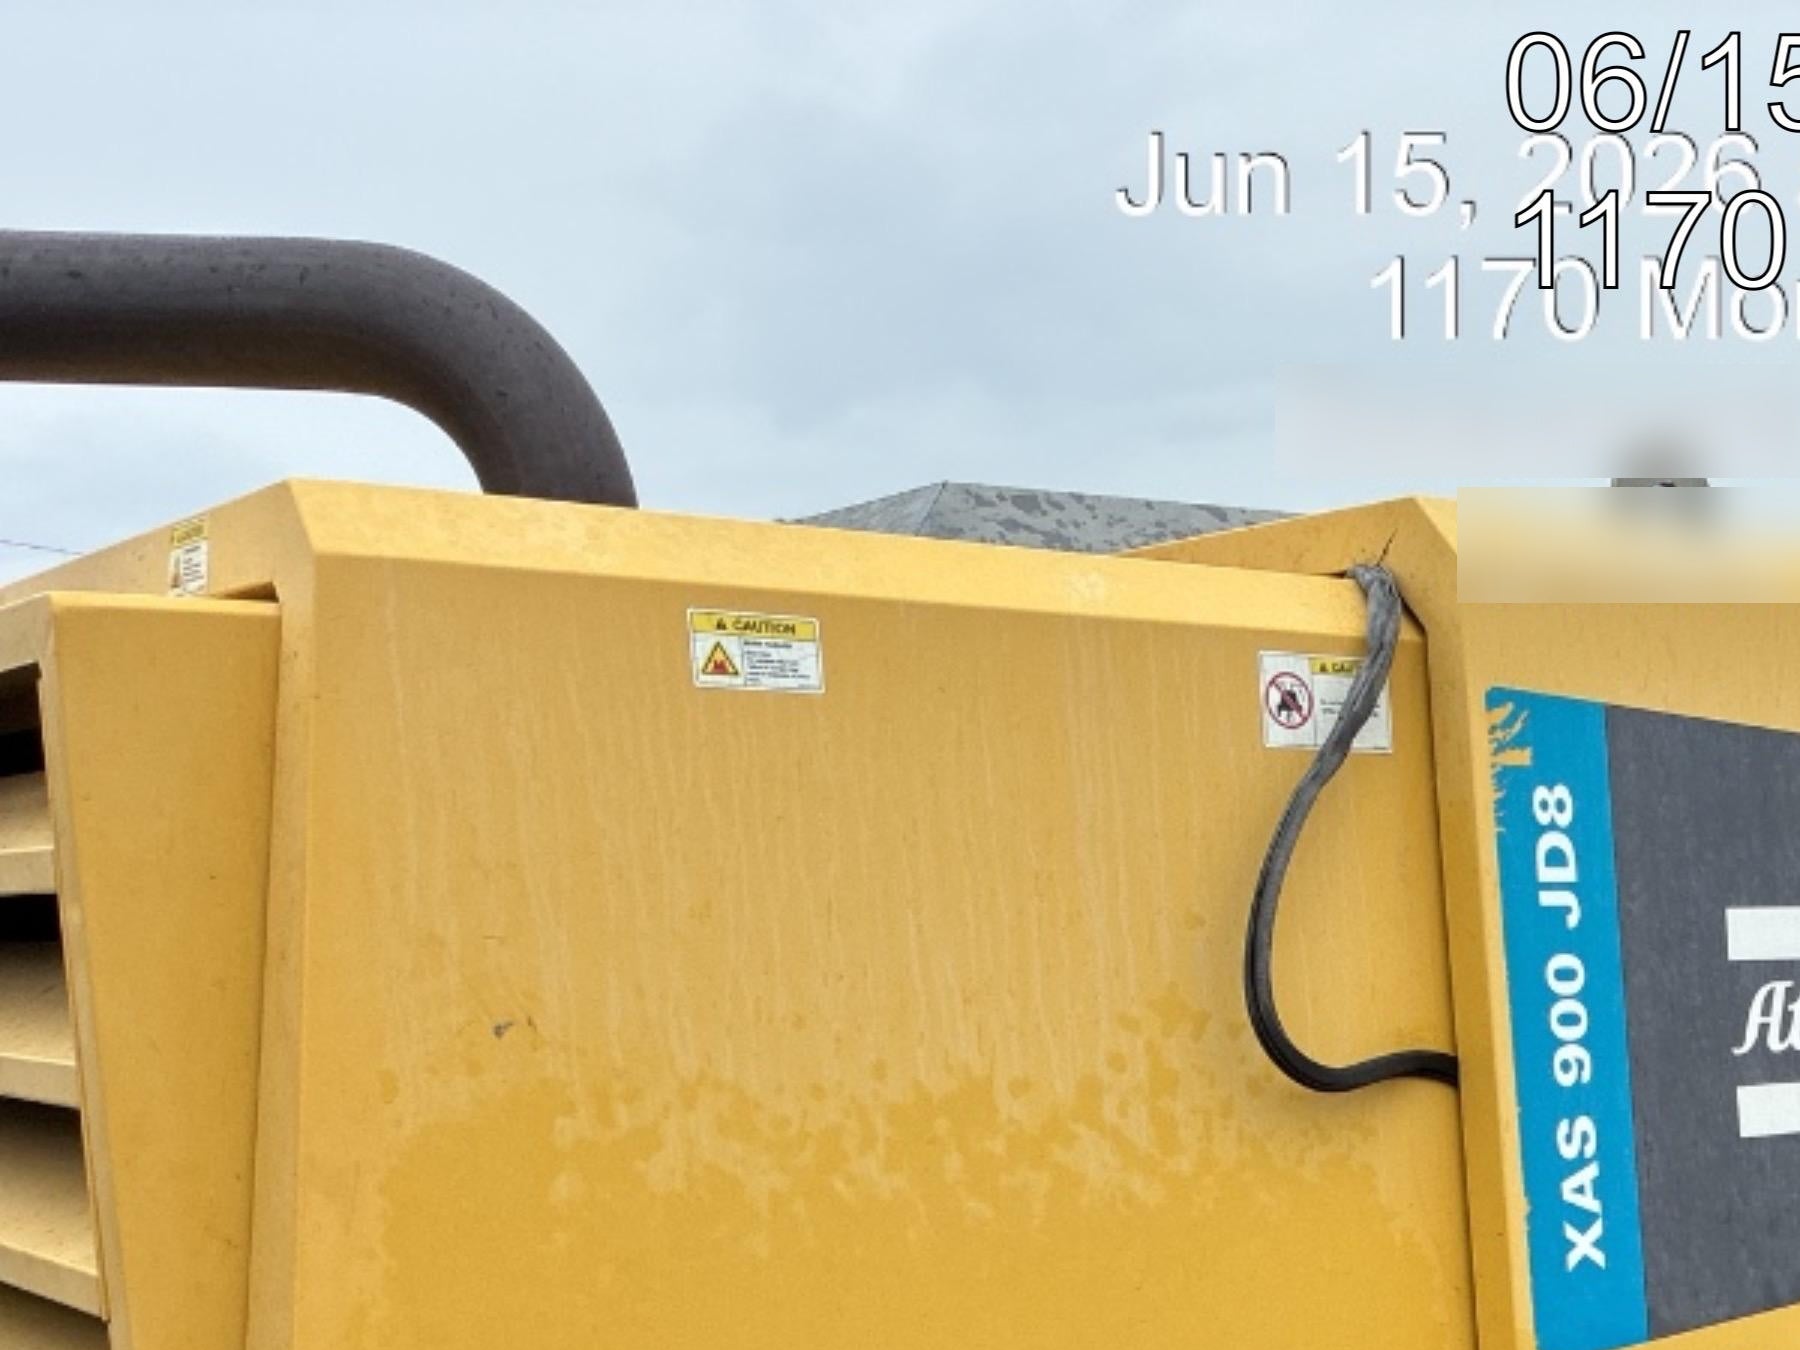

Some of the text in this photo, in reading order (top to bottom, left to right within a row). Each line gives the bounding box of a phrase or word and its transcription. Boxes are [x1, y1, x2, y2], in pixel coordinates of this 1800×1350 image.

[732, 616, 796, 636] CAUTION
[1531, 782, 1607, 1272] XAS 900 JD8
